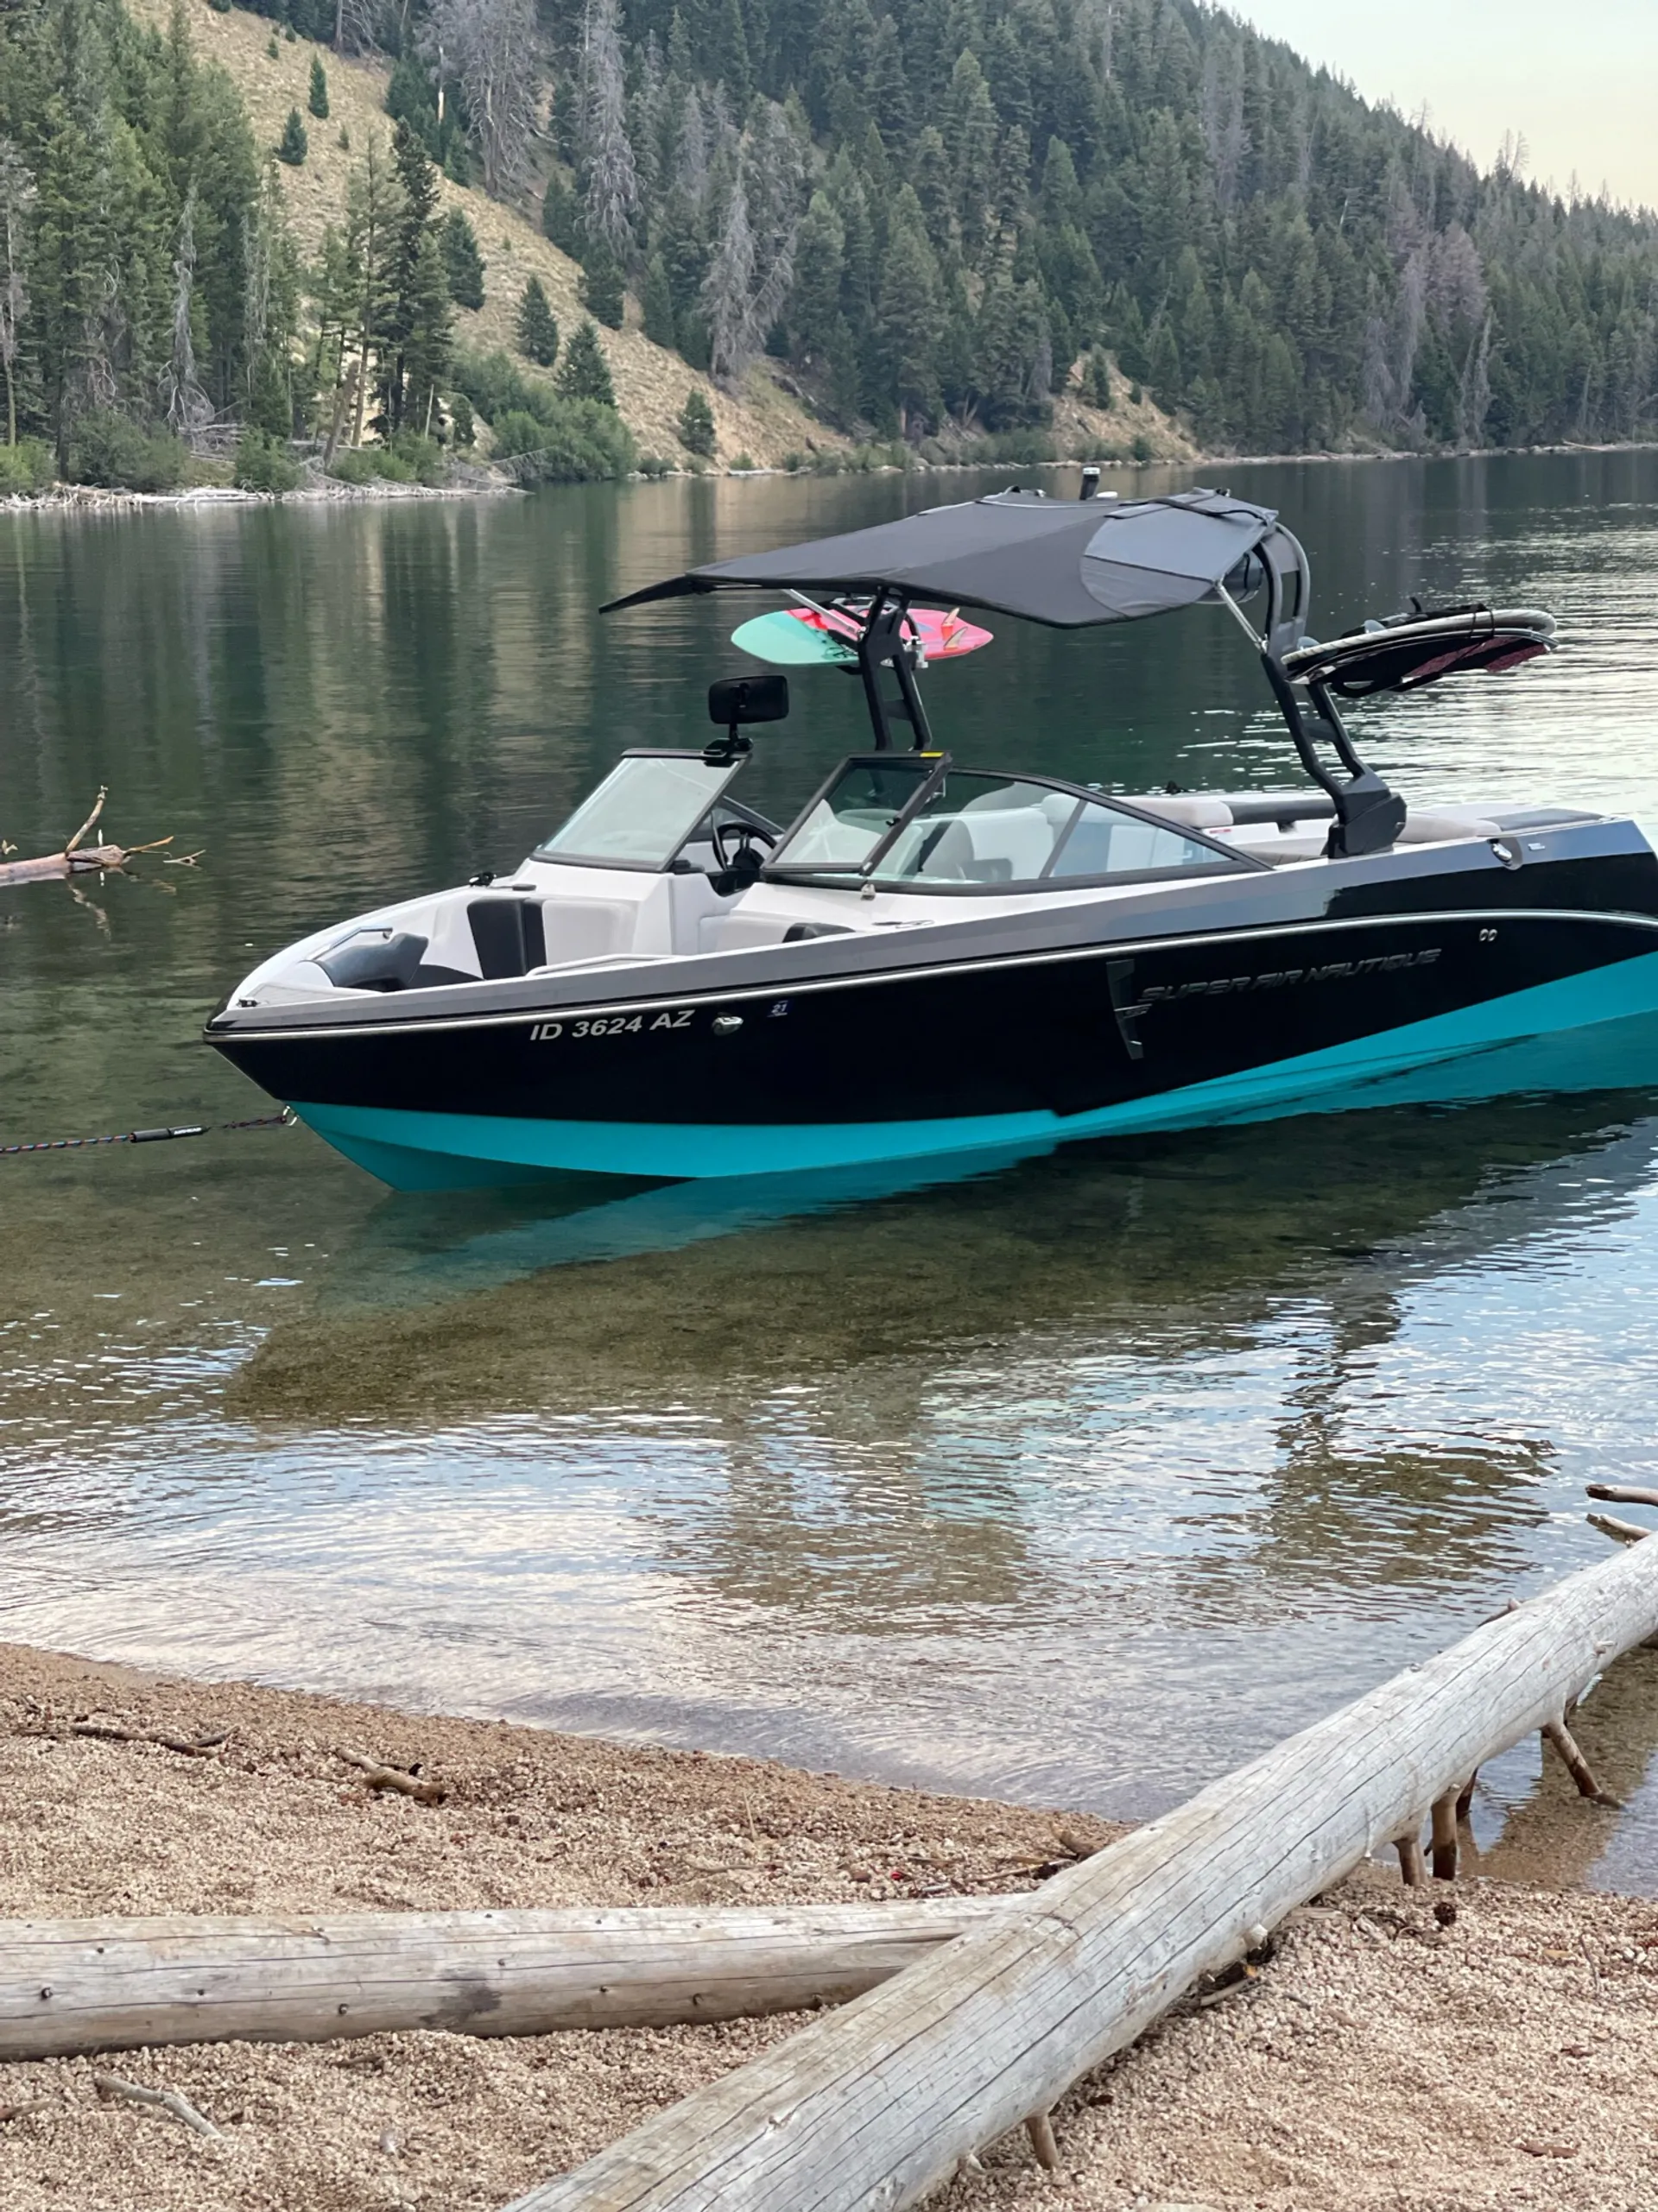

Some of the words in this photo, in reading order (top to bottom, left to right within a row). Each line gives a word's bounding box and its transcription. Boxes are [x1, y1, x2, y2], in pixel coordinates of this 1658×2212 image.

[1138, 976, 1250, 1002] SUPER
[1252, 970, 1303, 990] AIR
[1305, 948, 1442, 982] NAUTIQUE
[771, 1003, 787, 1014] 21
[530, 1024, 562, 1040] ID
[572, 1015, 642, 1038] 3624
[649, 1009, 696, 1030] AZ
